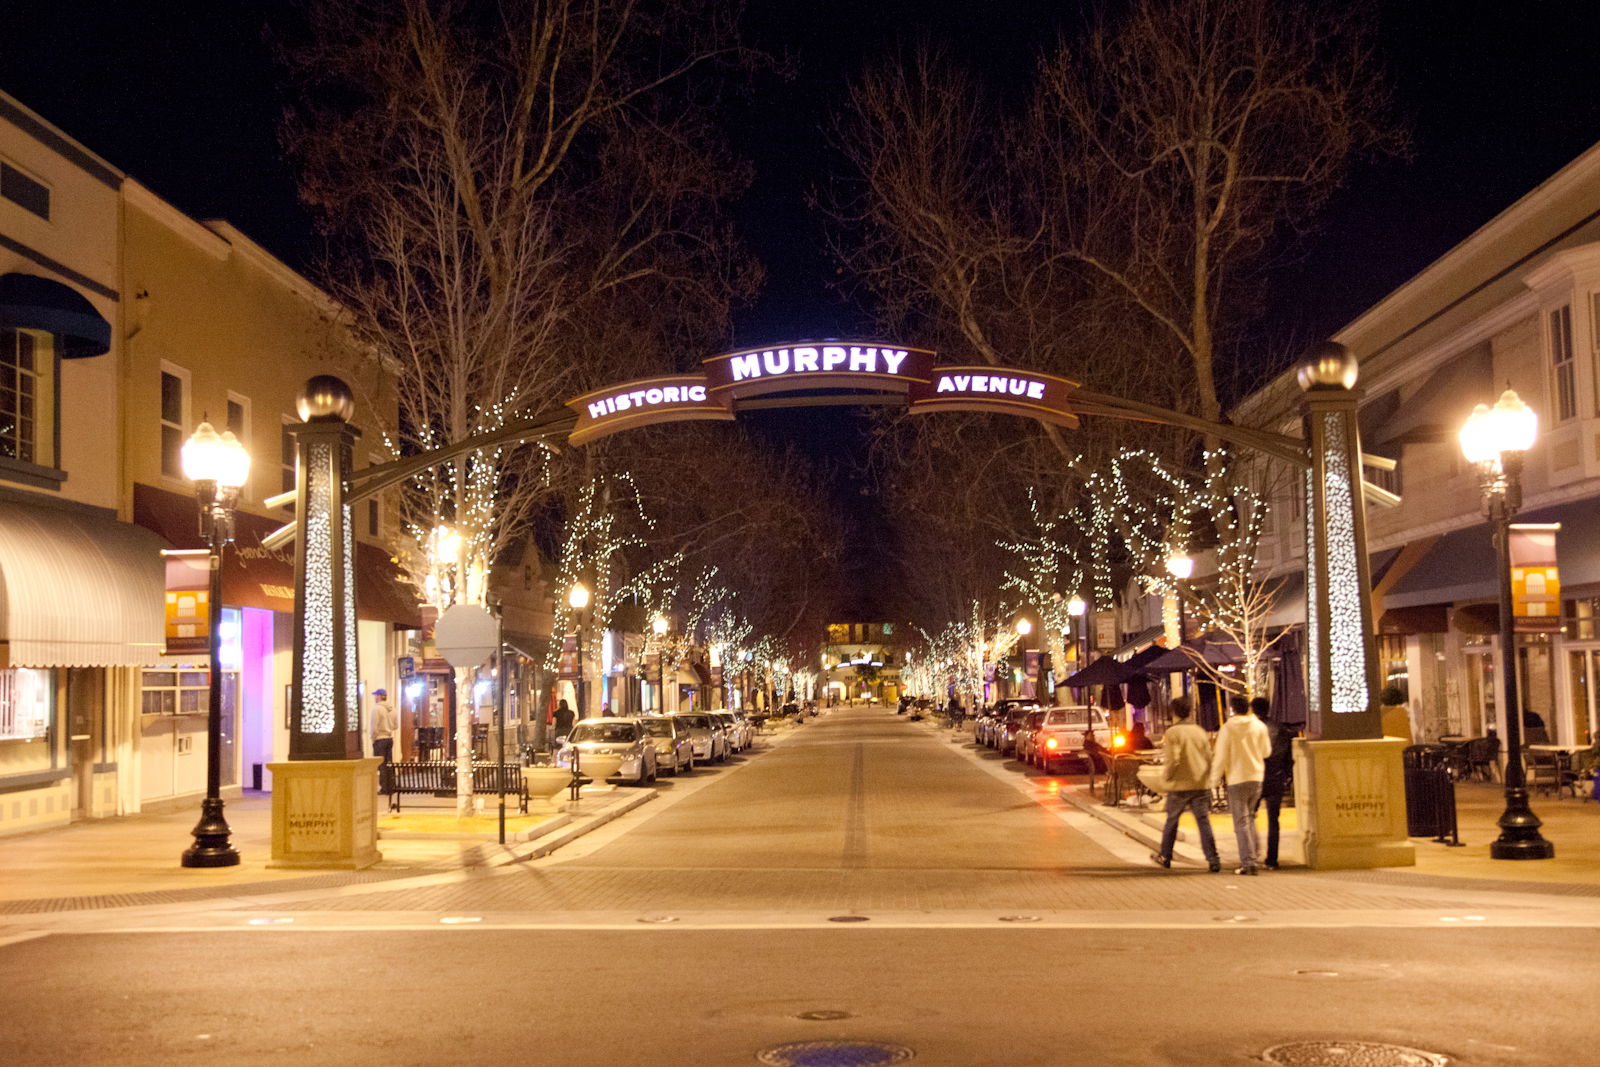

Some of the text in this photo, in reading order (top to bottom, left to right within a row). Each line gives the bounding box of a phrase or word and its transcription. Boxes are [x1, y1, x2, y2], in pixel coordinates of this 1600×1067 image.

[730, 347, 908, 381] MURPHY
[936, 375, 1046, 400] AVENUE
[588, 385, 707, 419] HISTORIC
[1336, 802, 1385, 810] MURPHY
[289, 820, 336, 828] MURPHY
